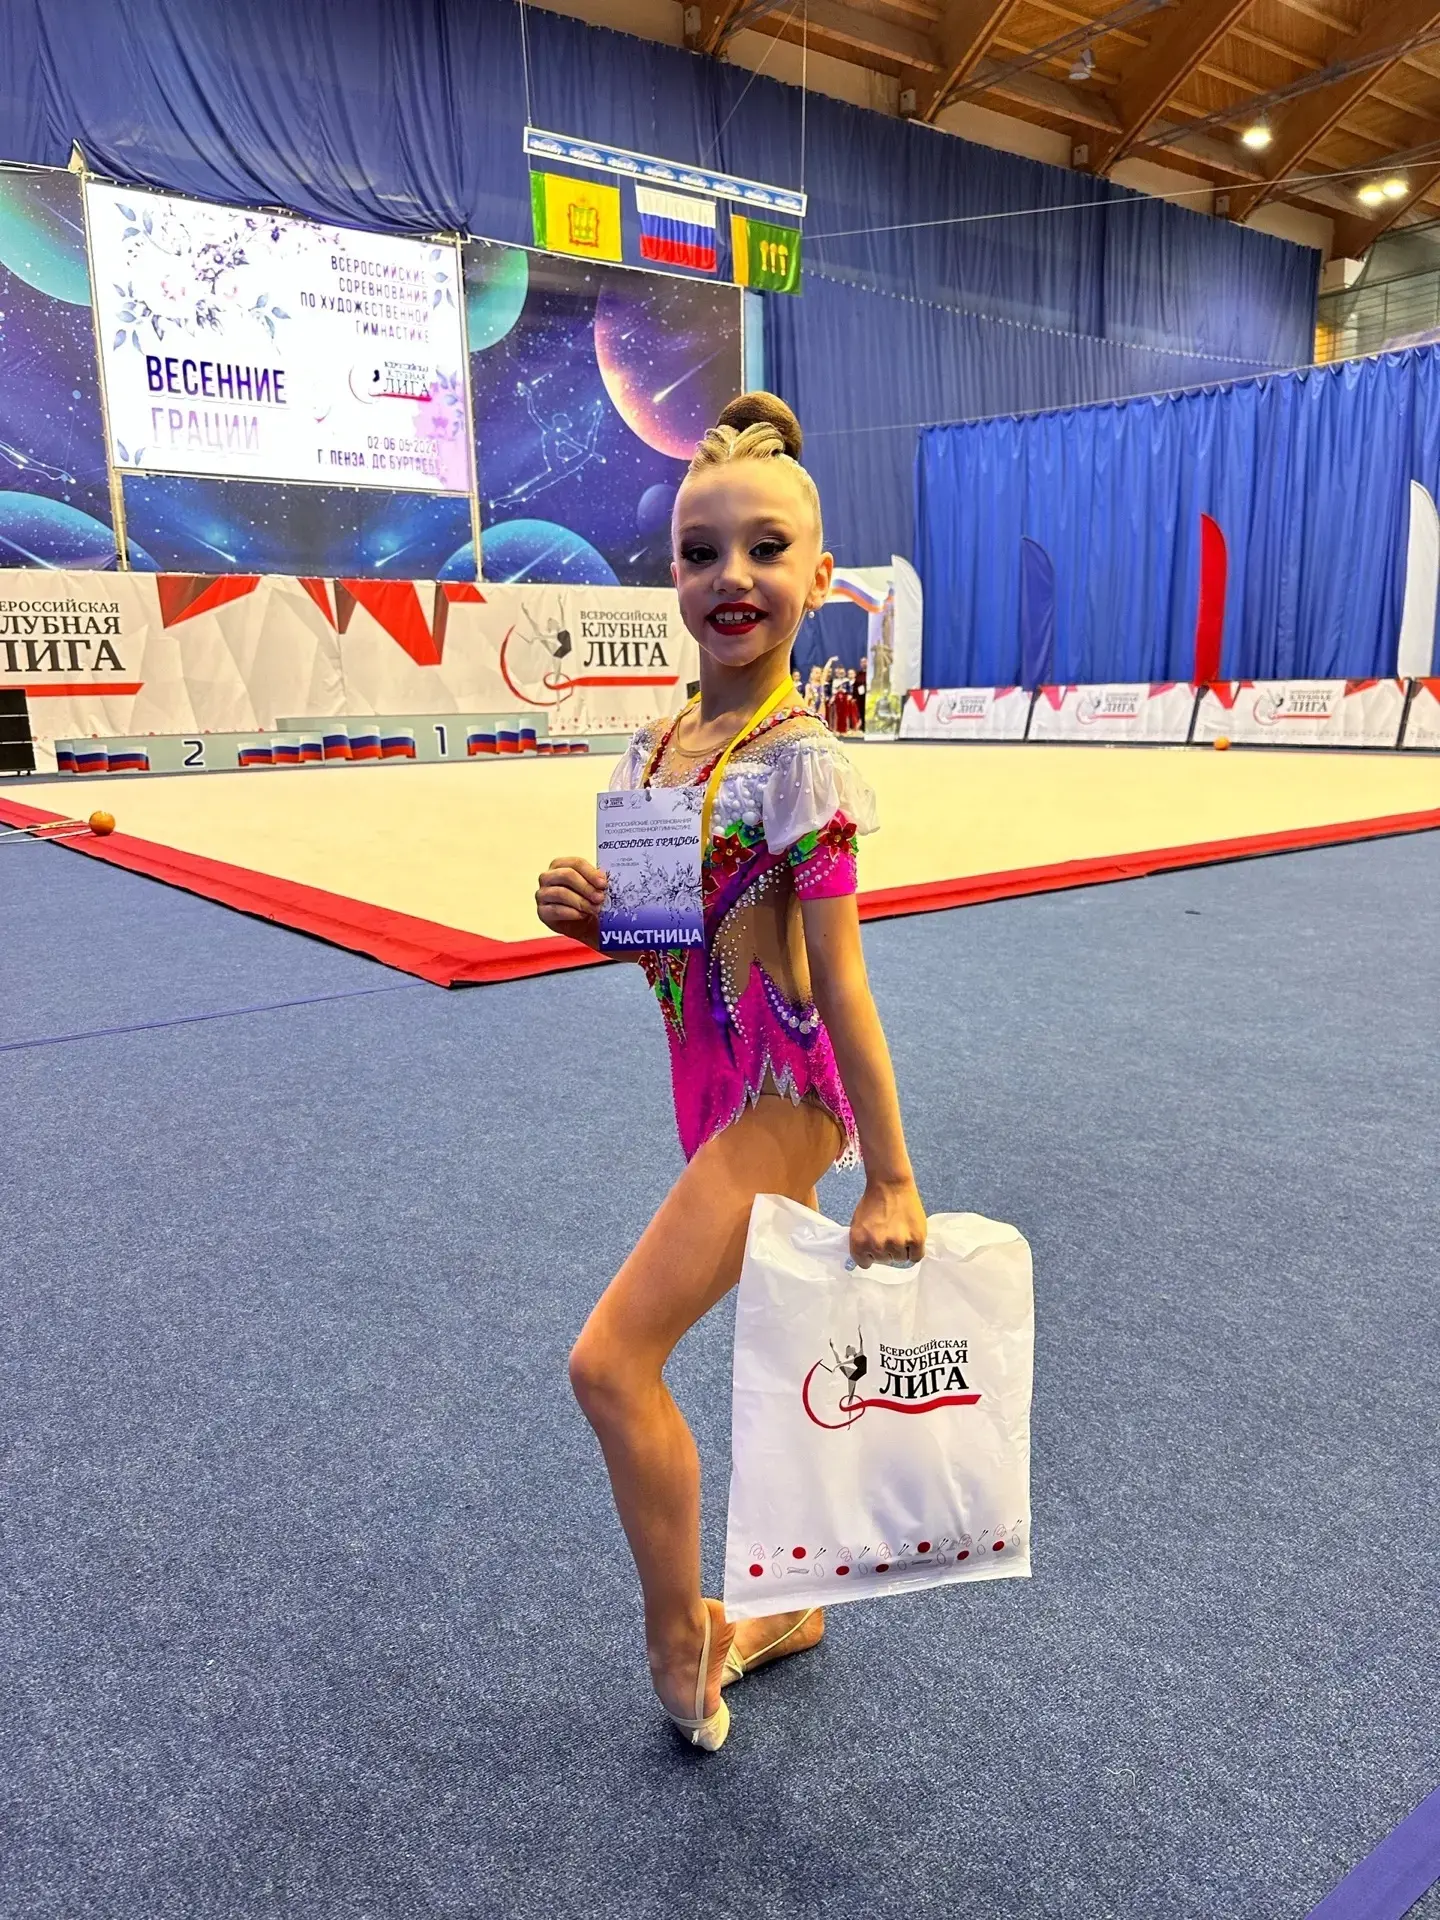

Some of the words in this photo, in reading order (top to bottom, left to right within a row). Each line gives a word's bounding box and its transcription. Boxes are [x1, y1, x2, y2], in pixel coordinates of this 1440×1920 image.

[331, 255, 425, 285] ВСЕРОССИЙСКИЕ
[300, 291, 316, 308] ПО
[339, 277, 428, 303] СОРЕВНОВАНИЯ
[356, 320, 429, 343] ГИМНАСТИКЕ
[146, 355, 287, 404] ВЕСЕННИЕ
[383, 377, 430, 397] ЛИГА
[151, 407, 260, 450] ГРАЦИИ
[372, 453, 386, 469] ДС
[0, 599, 120, 613] ЕРОССИЙСКАЯ
[580, 610, 668, 621] ВСЕРОССИЙСКАЯ
[0, 615, 122, 634] ЛУБНАЯ
[581, 622, 668, 638] КЛУБНАЯ
[583, 641, 670, 667] ЛИГА
[1287, 701, 1328, 712] ЛИГА
[435, 725, 447, 755] 1
[182, 740, 205, 767] 2
[601, 928, 702, 945] УЧАСТНИЦА
[879, 1339, 968, 1358] ВСЕРОССИЙСКАЯ
[879, 1349, 969, 1373] КЛУБНАЯ
[879, 1366, 969, 1399] ЛИГА
